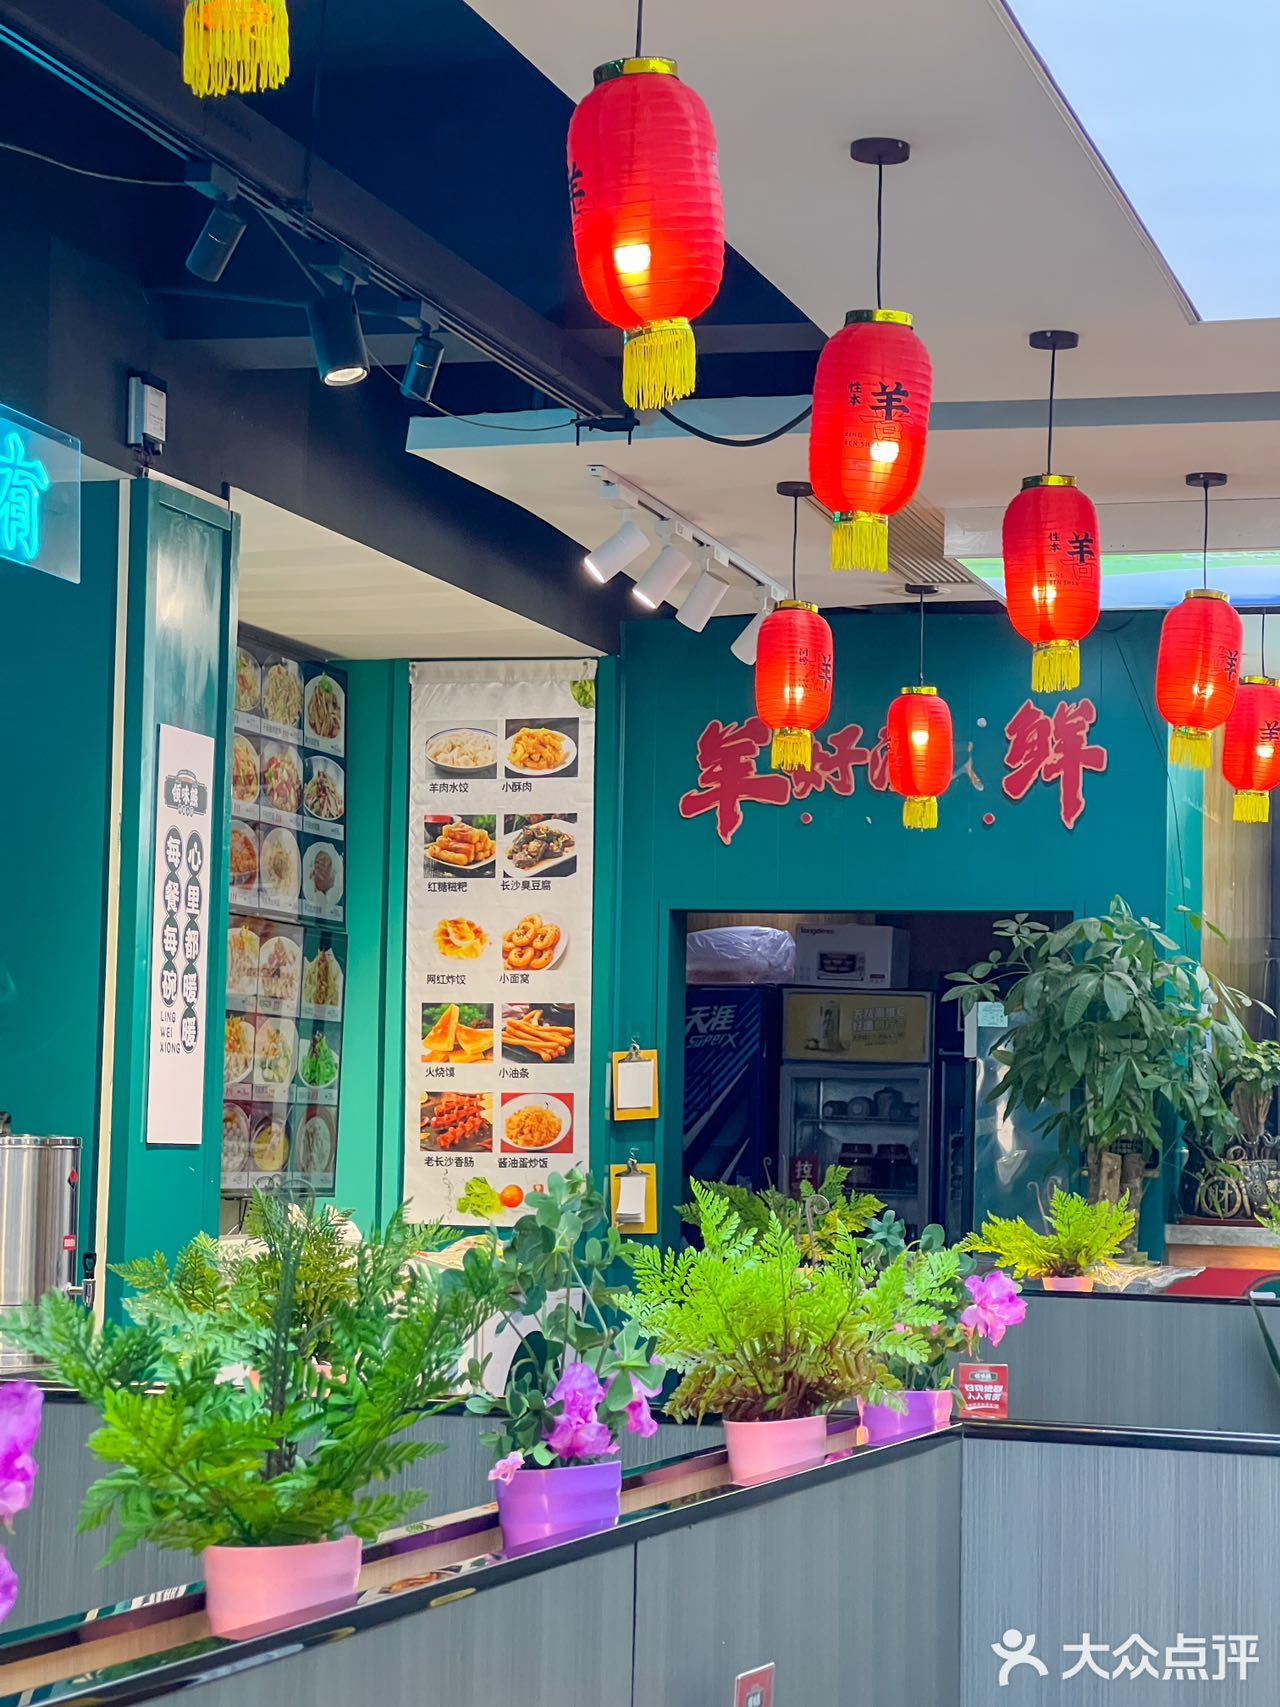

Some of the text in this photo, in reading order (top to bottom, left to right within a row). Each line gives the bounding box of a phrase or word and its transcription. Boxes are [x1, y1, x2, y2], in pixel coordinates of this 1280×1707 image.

[429, 781, 469, 793] 羊肉水饺
[501, 781, 532, 793] 小酥肉
[427, 881, 468, 893] 红糖糍粑
[500, 880, 551, 891] 长沙臭豆腐
[426, 973, 466, 985] 网红炸饺
[499, 973, 530, 984] 小面窝
[160, 1011, 176, 1022] LING
[160, 1027, 173, 1038] WEI
[159, 1042, 181, 1054] XIONG
[498, 1067, 529, 1079] 小油条
[424, 1156, 475, 1168] 老长沙香肠
[498, 1157, 549, 1169] 酱油蛋炒饭
